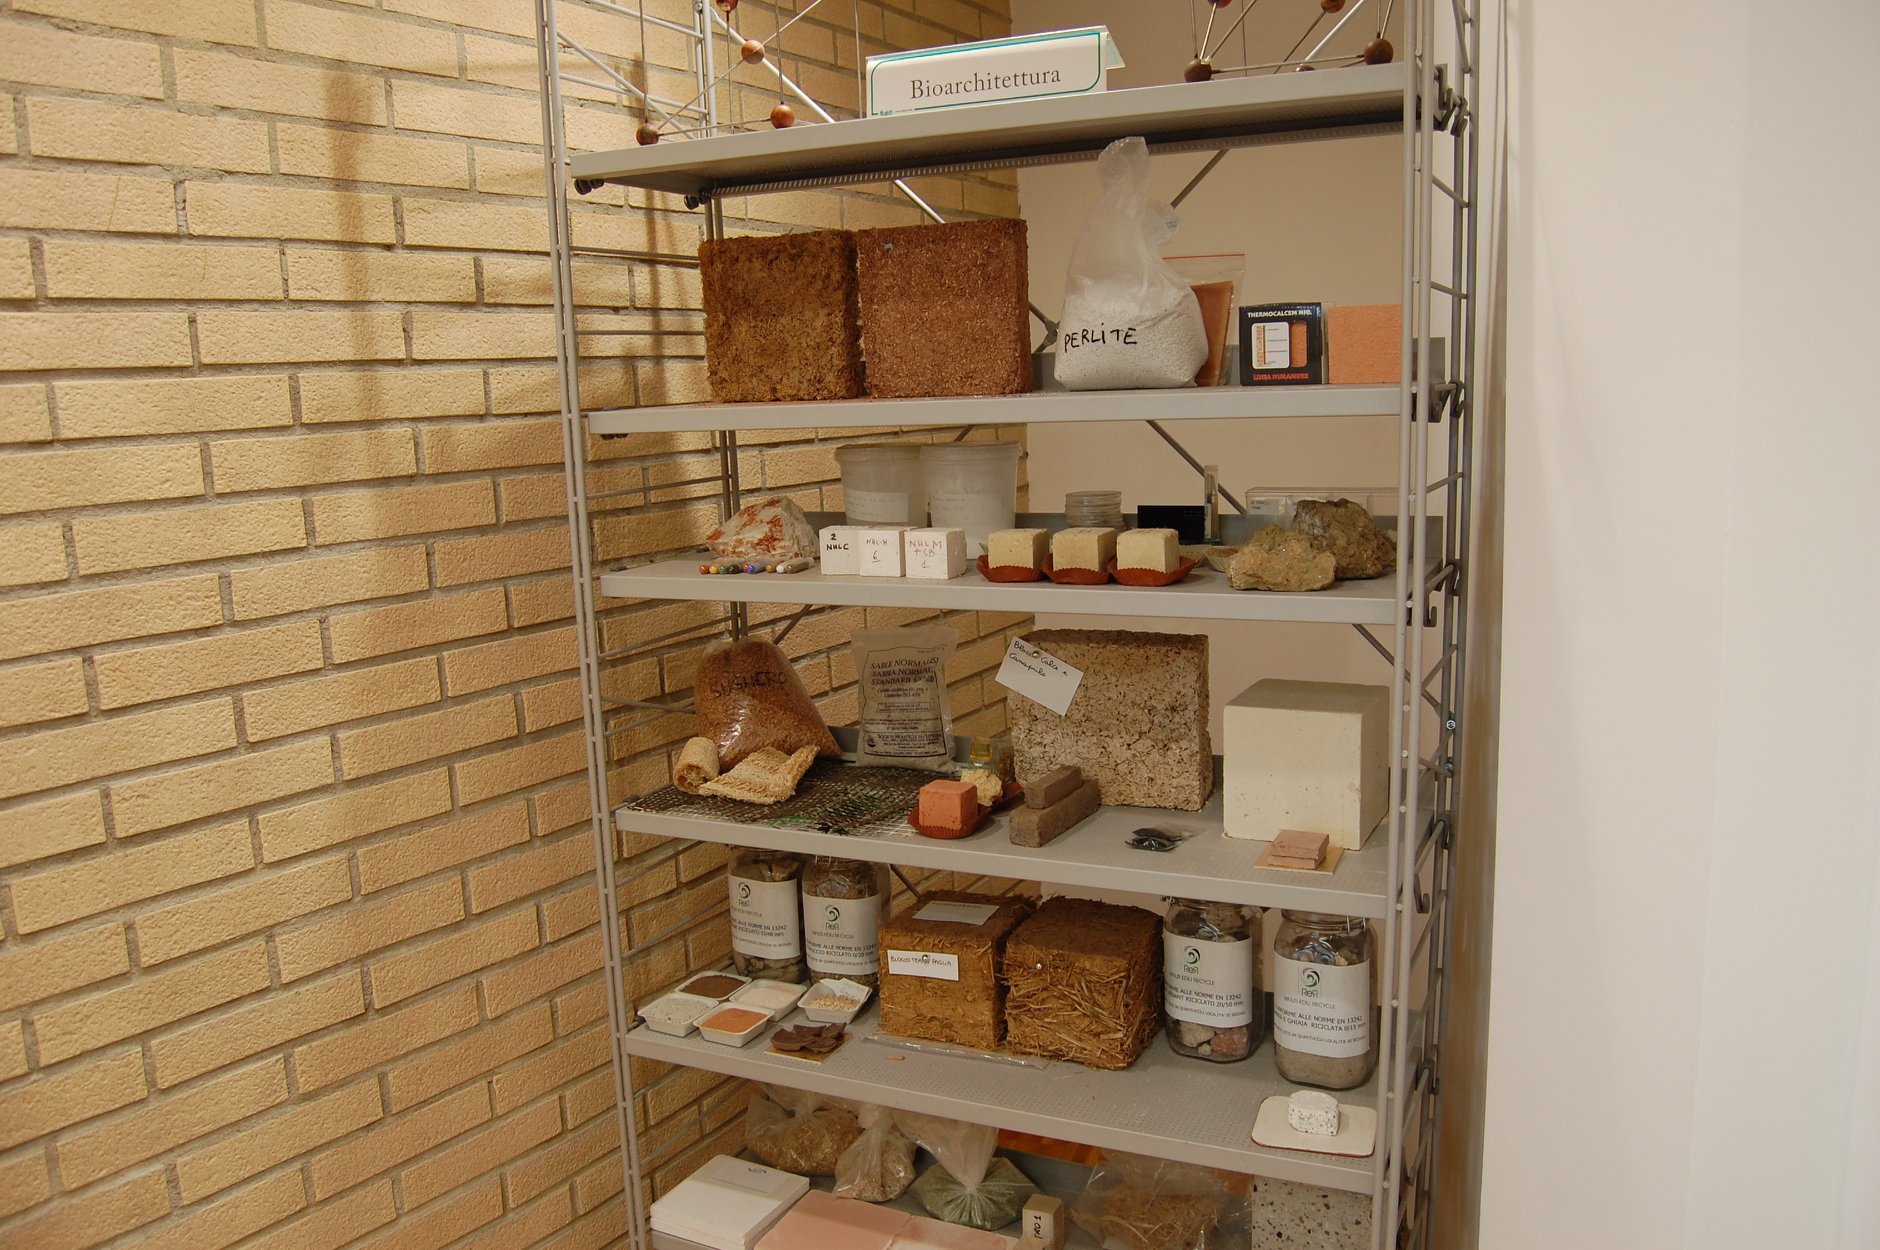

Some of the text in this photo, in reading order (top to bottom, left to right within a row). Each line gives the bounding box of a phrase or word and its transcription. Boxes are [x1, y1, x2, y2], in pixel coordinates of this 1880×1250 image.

[910, 69, 1061, 99] Bioarchitettura
[1064, 322, 1138, 353] PERLITE
[830, 533, 837, 541] 2
[871, 677, 911, 686] STANDARD
[1194, 991, 1214, 999] NORME
[1298, 1012, 1312, 1021] ALLE
[1313, 1015, 1335, 1024] NORME
[1347, 1015, 1363, 1024] 13242
[1311, 1023, 1343, 1032] RICICLATA
